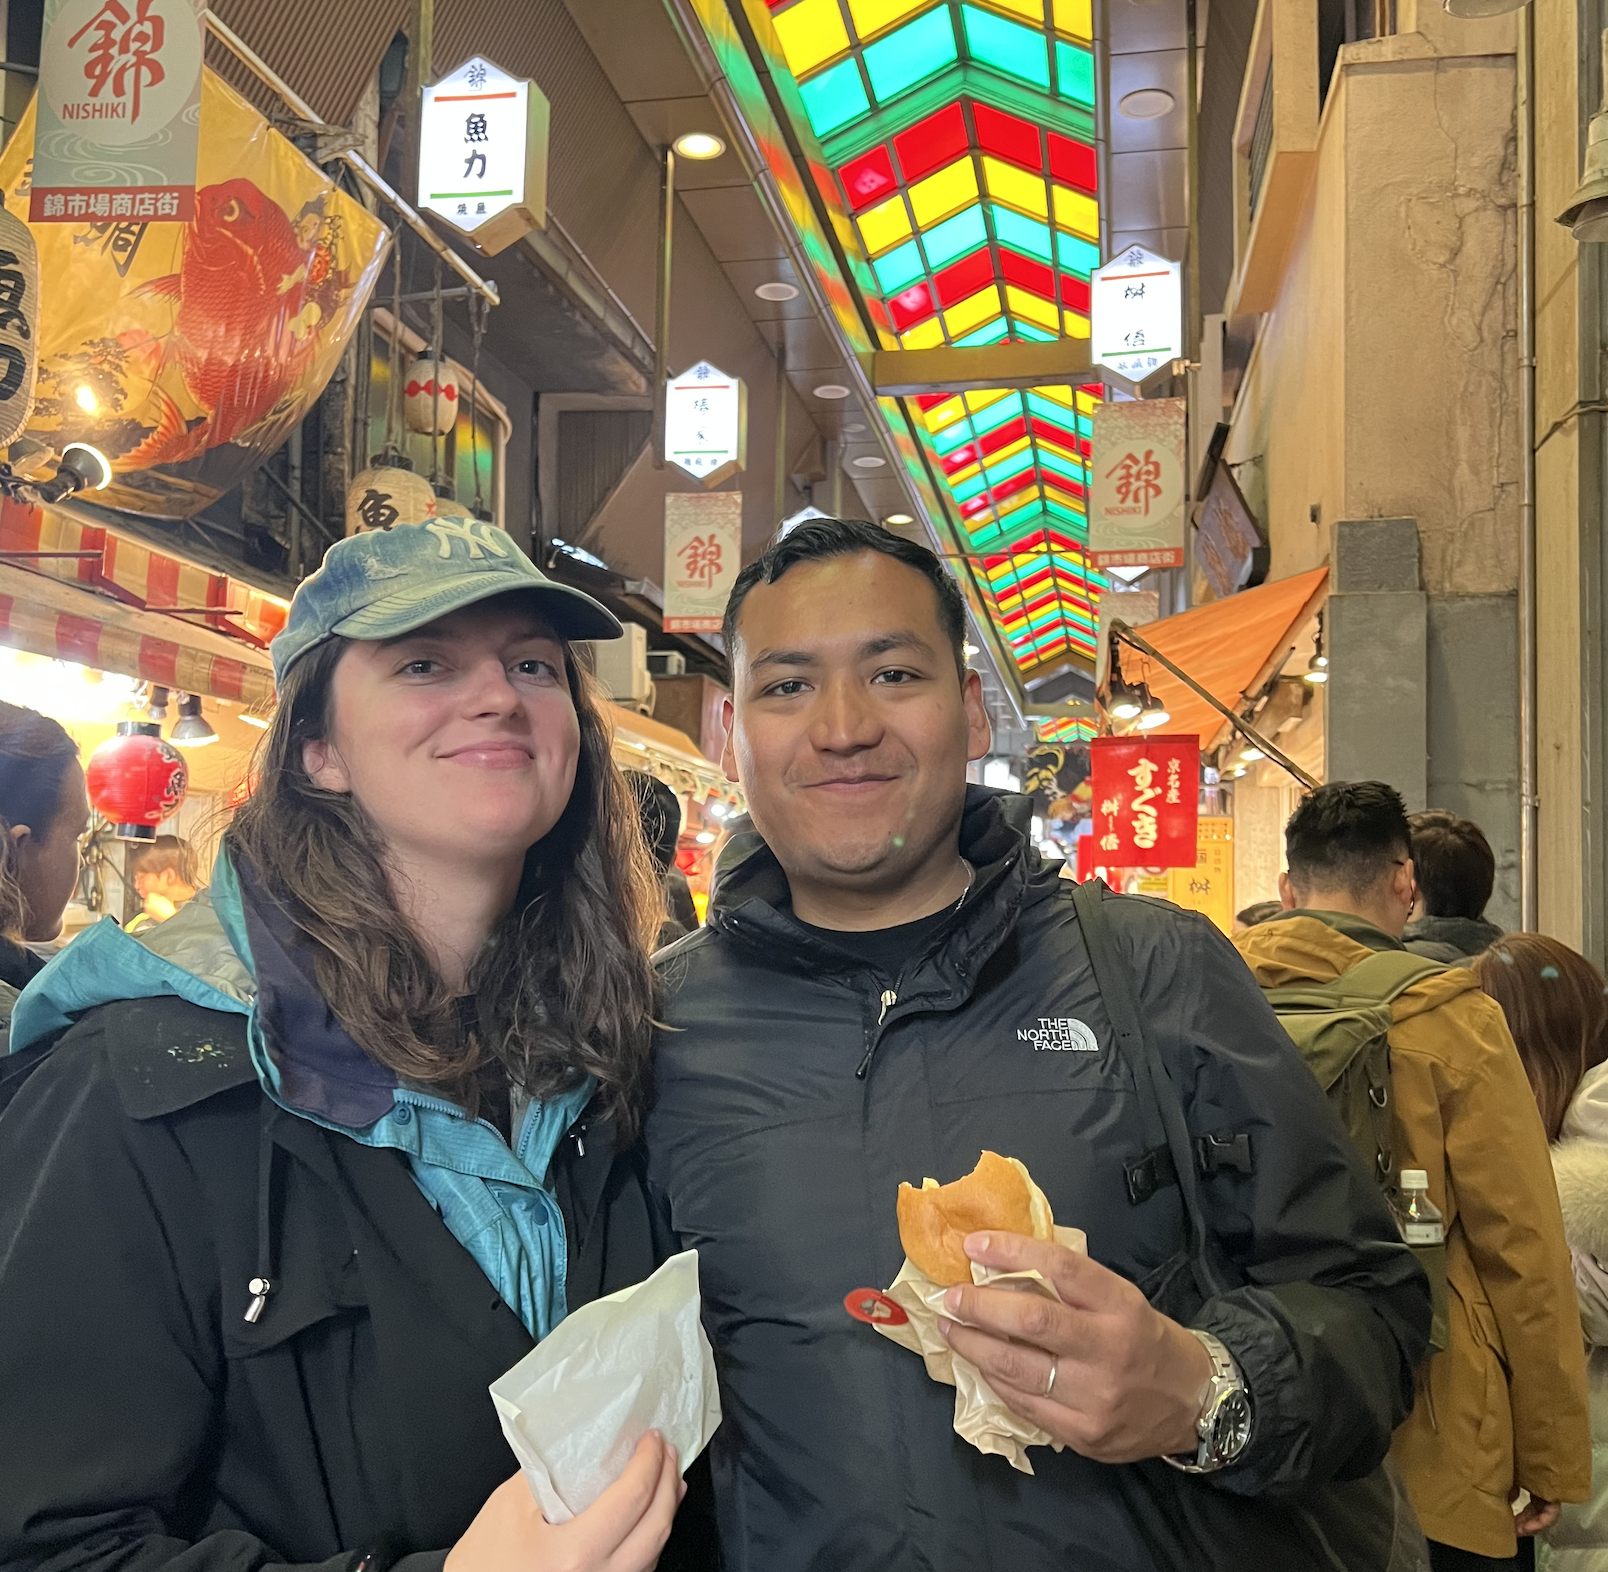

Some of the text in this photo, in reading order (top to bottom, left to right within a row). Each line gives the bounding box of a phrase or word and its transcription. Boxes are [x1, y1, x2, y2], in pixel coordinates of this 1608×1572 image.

[67, 0, 166, 125] 錦
[62, 102, 127, 121] NISHIKI
[463, 113, 488, 180] 魚力
[43, 192, 180, 217] 錦市場商店街
[1105, 449, 1163, 516] 錦
[426, 517, 508, 559] NY
[677, 533, 724, 589] 錦
[1127, 758, 1163, 849] すぐき
[1016, 1029, 1069, 1041] NORTH
[1037, 1018, 1068, 1030] THE
[1033, 1040, 1072, 1051] FACE
